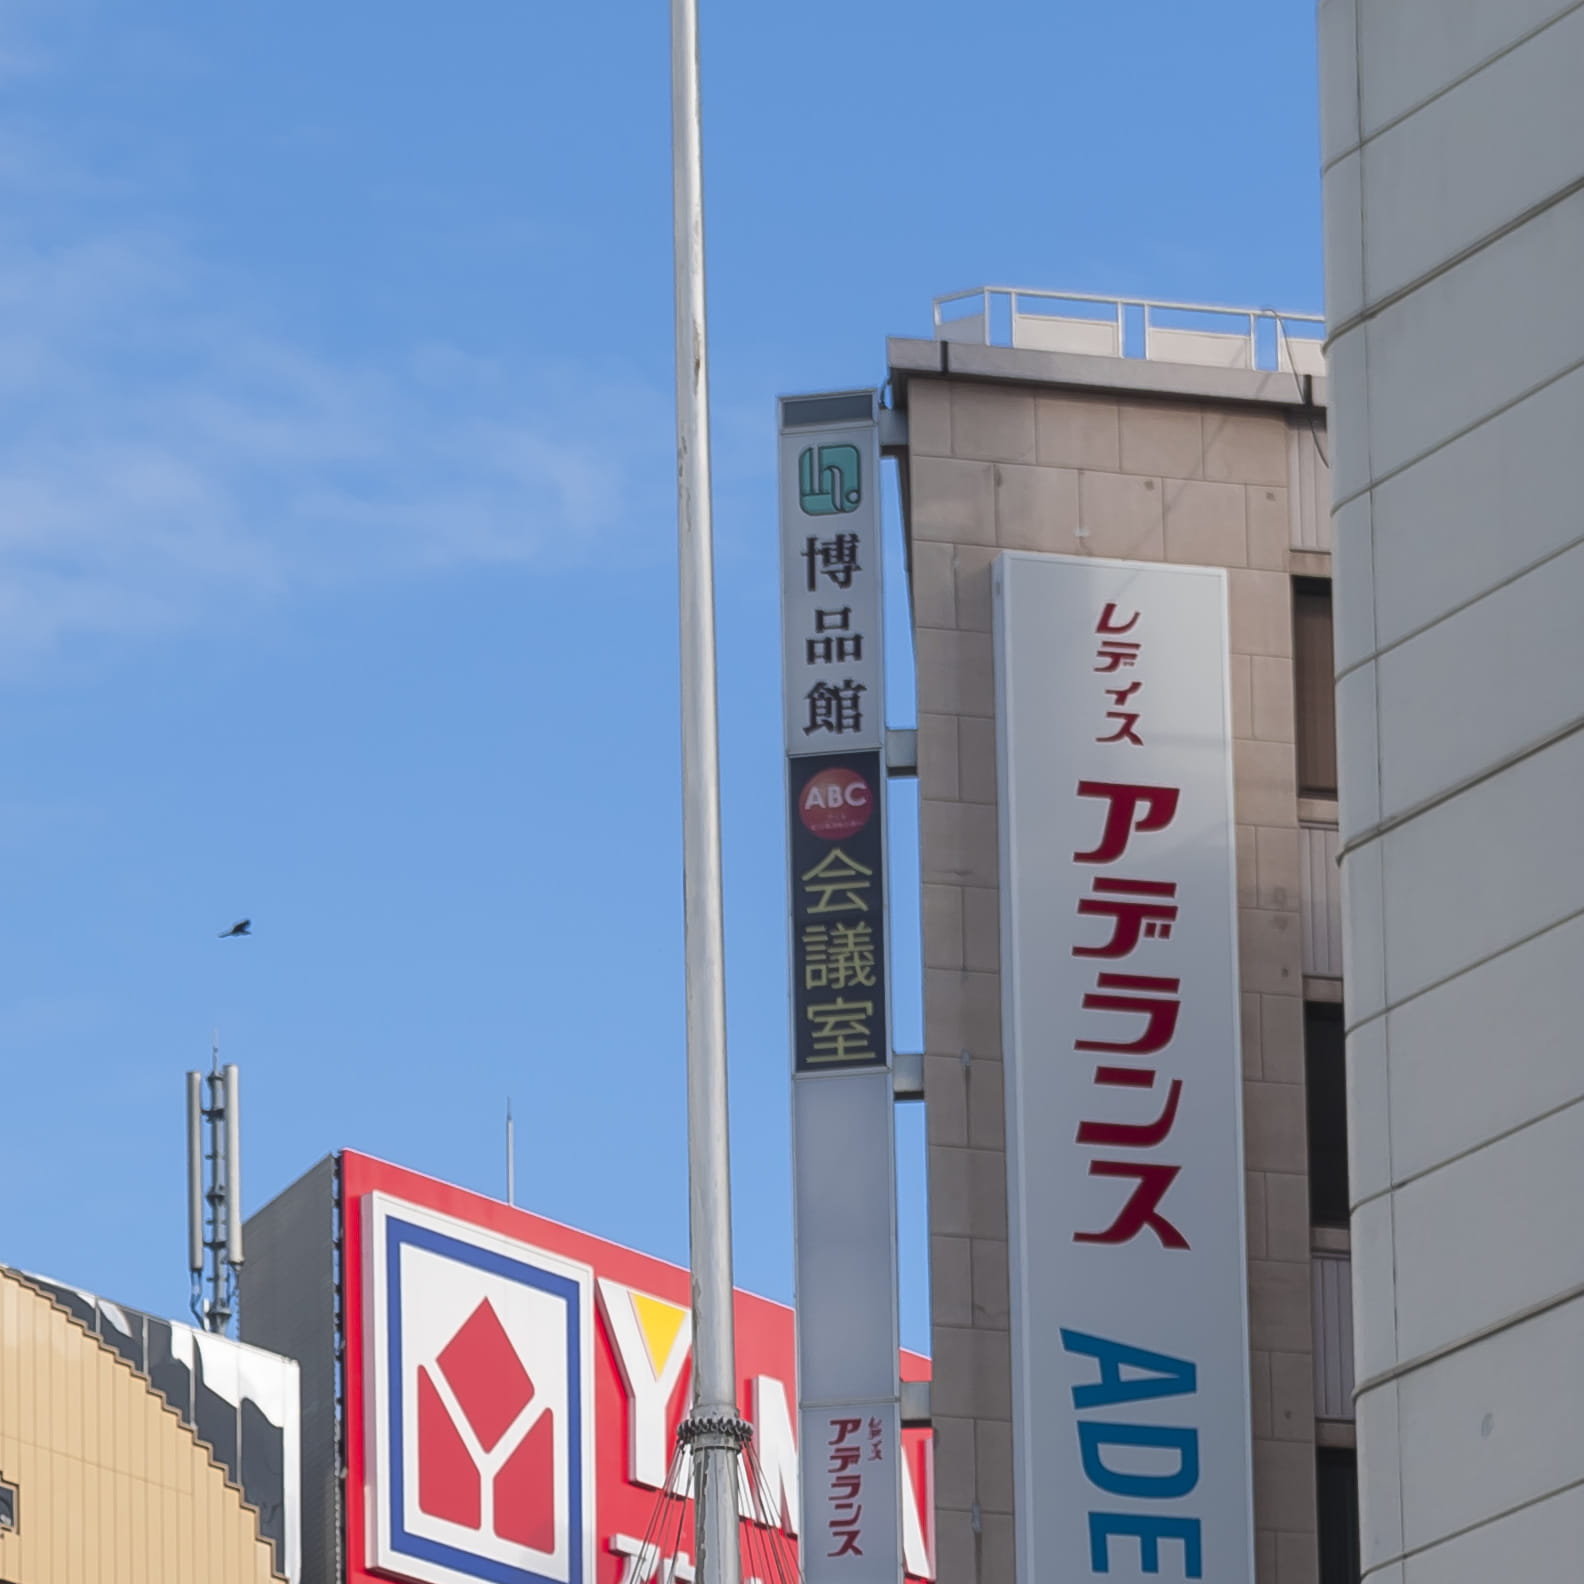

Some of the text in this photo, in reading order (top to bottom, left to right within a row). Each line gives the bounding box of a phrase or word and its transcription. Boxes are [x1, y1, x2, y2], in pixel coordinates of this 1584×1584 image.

[800, 532, 867, 737] 博品館
[1092, 601, 1145, 747] レディス
[804, 782, 868, 811] ABC
[801, 847, 877, 1064] 会議室
[1071, 779, 1192, 1252] アデランス
[826, 1417, 865, 1558] アデランス
